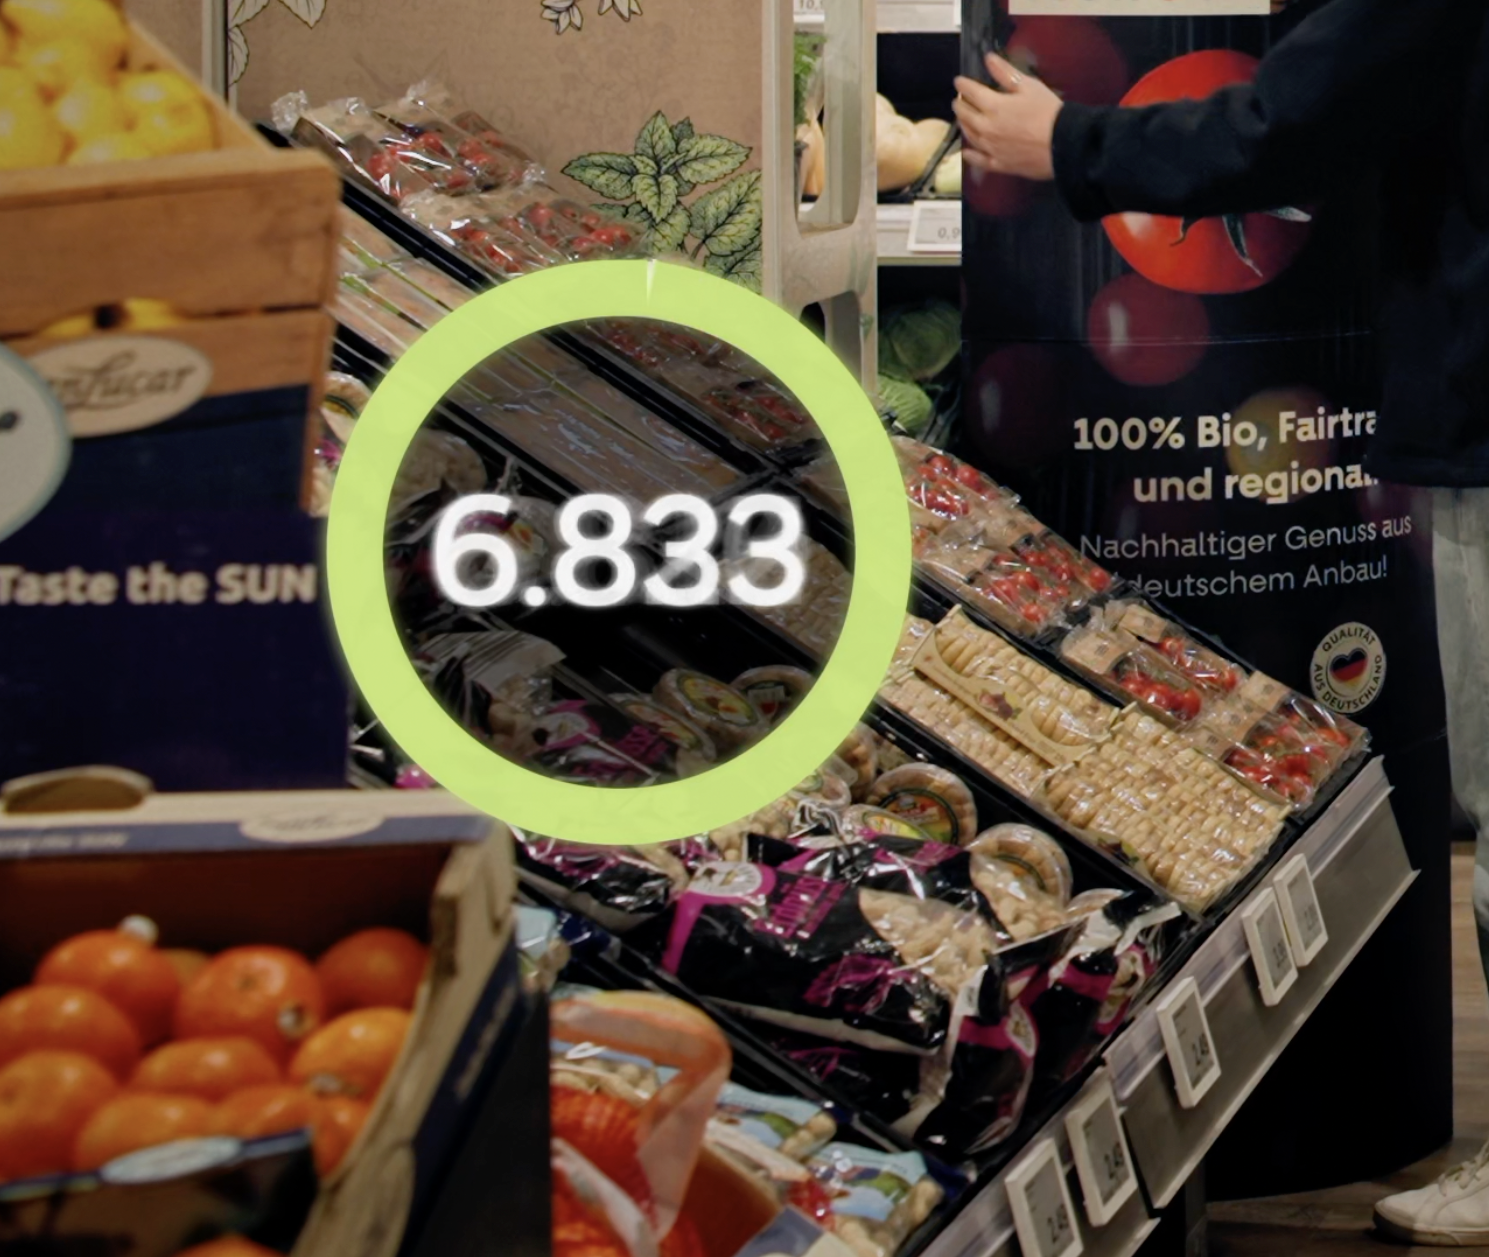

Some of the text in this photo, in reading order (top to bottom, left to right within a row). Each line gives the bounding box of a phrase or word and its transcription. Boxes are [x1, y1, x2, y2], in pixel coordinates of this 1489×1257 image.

[1073, 406, 1377, 451] 100% Bio, Fairtra
[1133, 467, 1212, 502] und
[1080, 515, 1412, 560] Nachhaltiger Genuss aus
[0, 559, 318, 606] Taste the SUN
[1303, 555, 1388, 589] Anbau!
[1322, 627, 1376, 652] QUALITÄT
[1313, 654, 1383, 710] AUS DEUTSCHLAND
